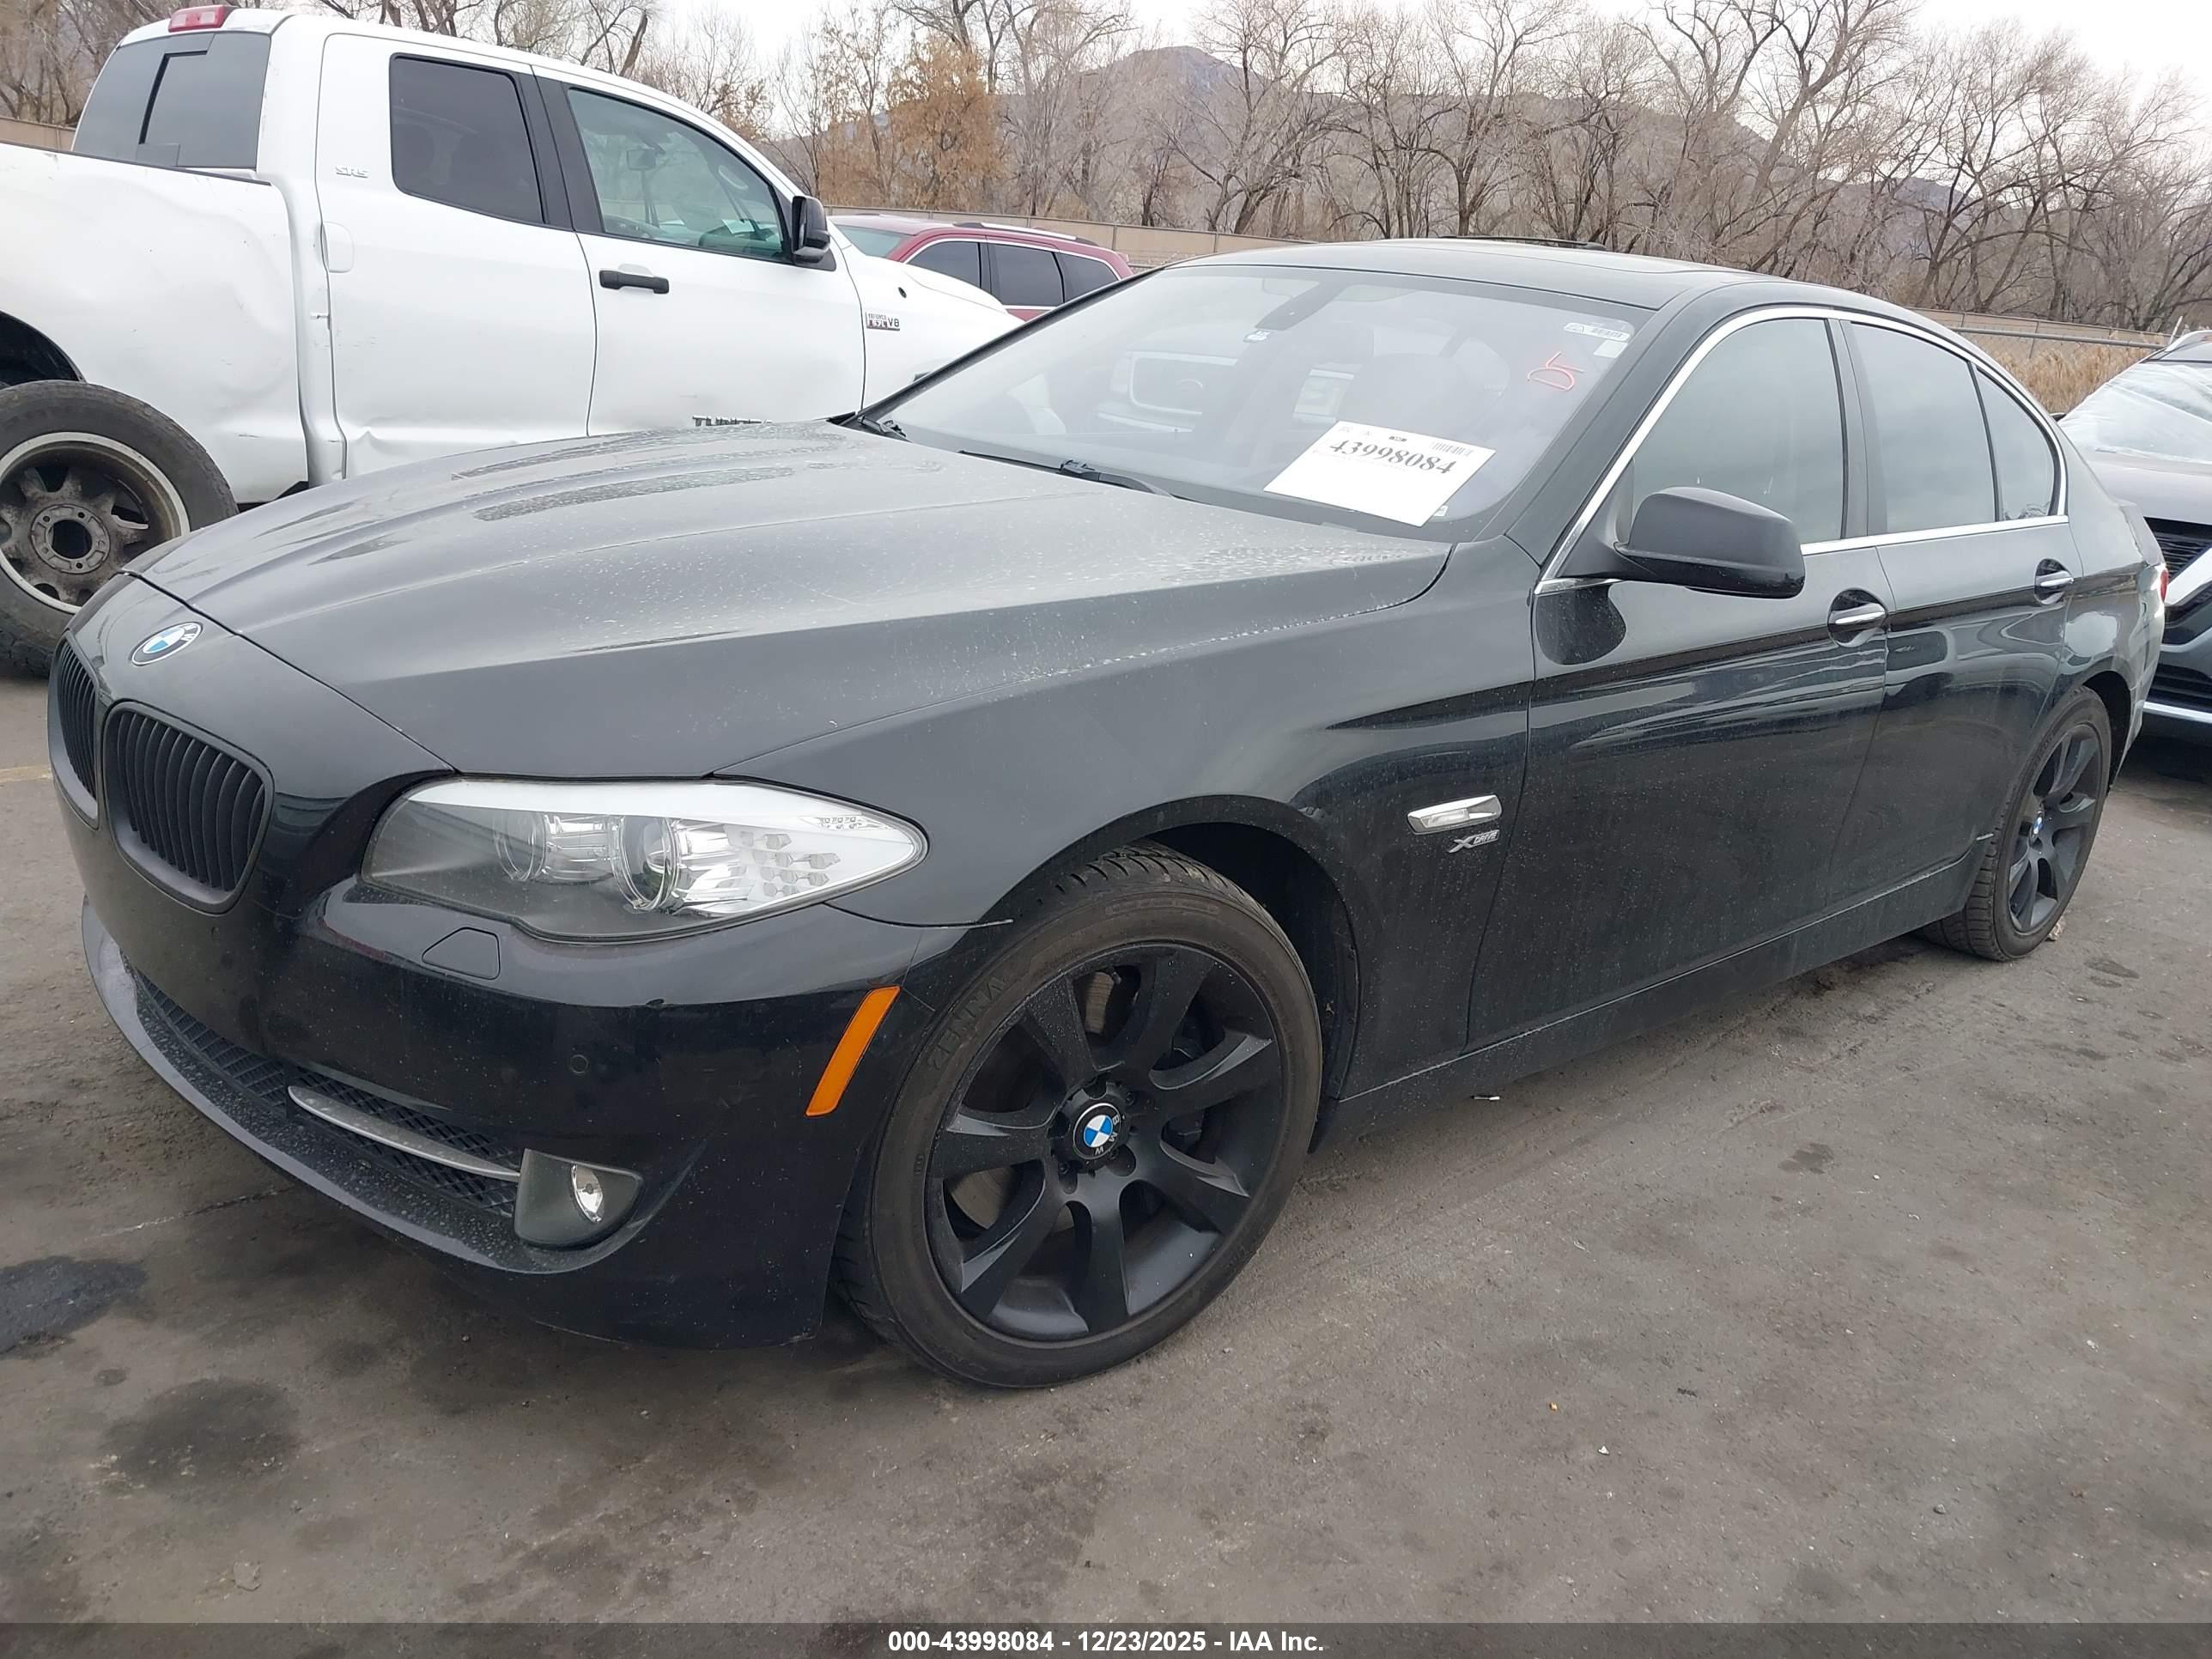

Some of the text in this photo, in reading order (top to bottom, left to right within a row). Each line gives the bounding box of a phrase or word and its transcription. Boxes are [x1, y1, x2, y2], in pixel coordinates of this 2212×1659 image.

[887, 317, 900, 328] V8
[692, 415, 773, 428] TUN
[1329, 440, 1457, 474] 43998084
